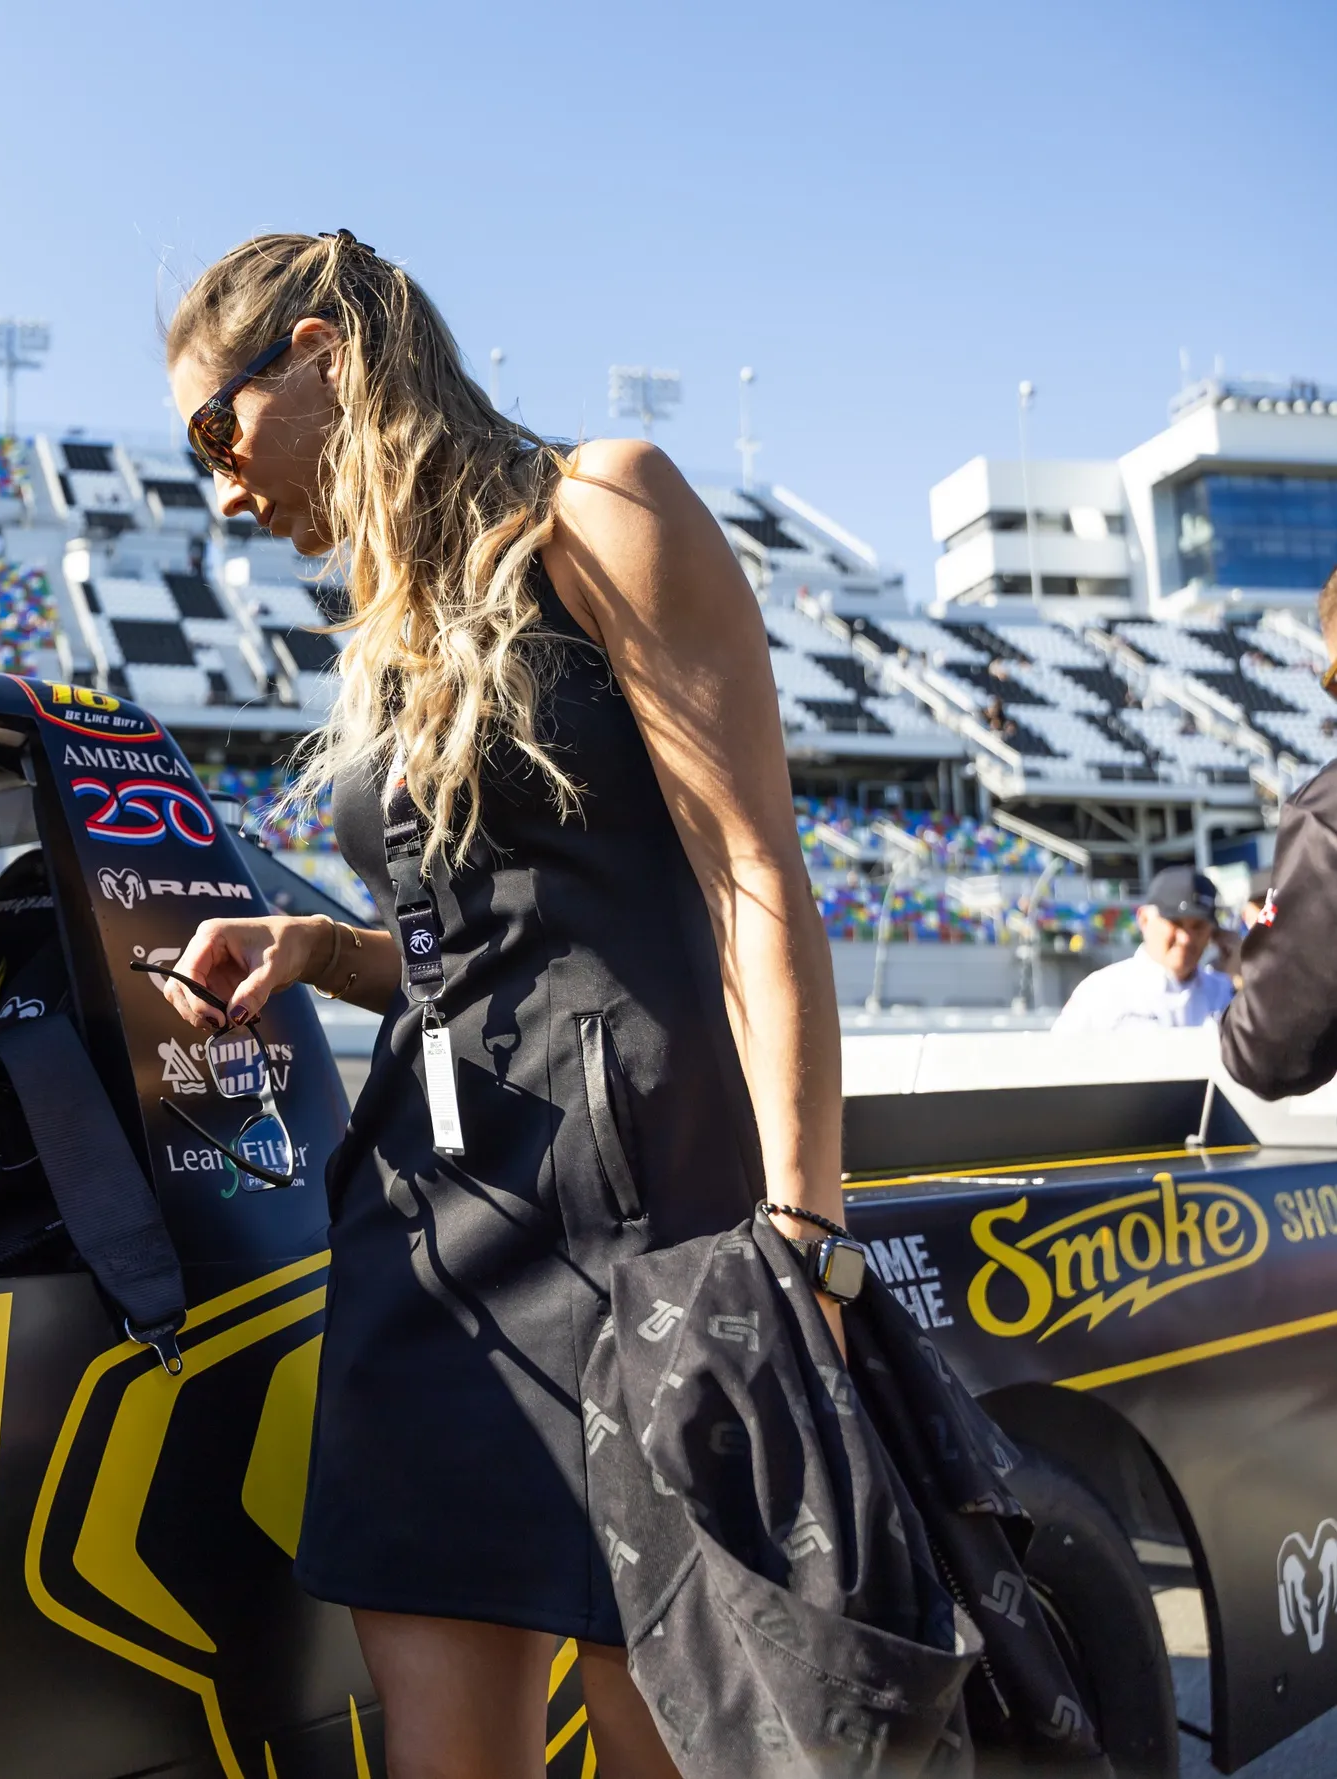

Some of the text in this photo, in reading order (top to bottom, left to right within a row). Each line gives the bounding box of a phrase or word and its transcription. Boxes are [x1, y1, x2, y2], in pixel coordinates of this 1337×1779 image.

[84, 712, 109, 724] LIKE
[63, 744, 190, 779] AMERICA
[70, 777, 216, 848] 250
[148, 880, 252, 900] RAM
[966, 1172, 1269, 1344] Smoke
